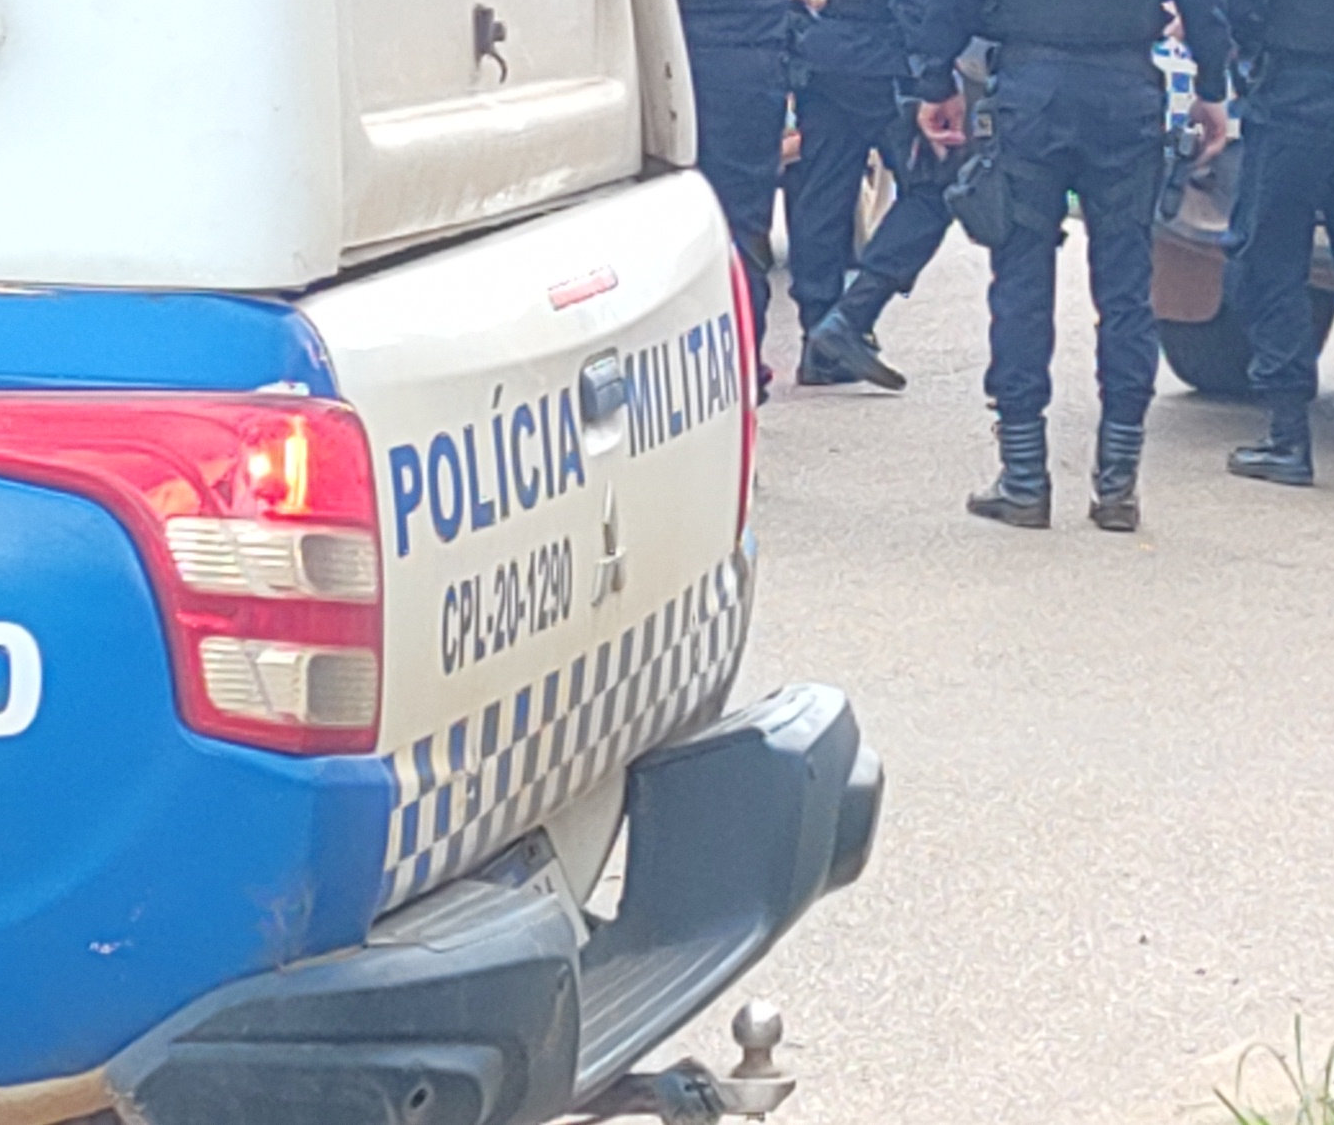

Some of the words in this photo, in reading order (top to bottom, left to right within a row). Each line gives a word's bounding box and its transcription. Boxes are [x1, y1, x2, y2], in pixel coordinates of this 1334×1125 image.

[388, 383, 586, 558] POLÍCIA
[622, 312, 740, 458] MILITAR
[441, 535, 574, 676] CPL-20-1290
